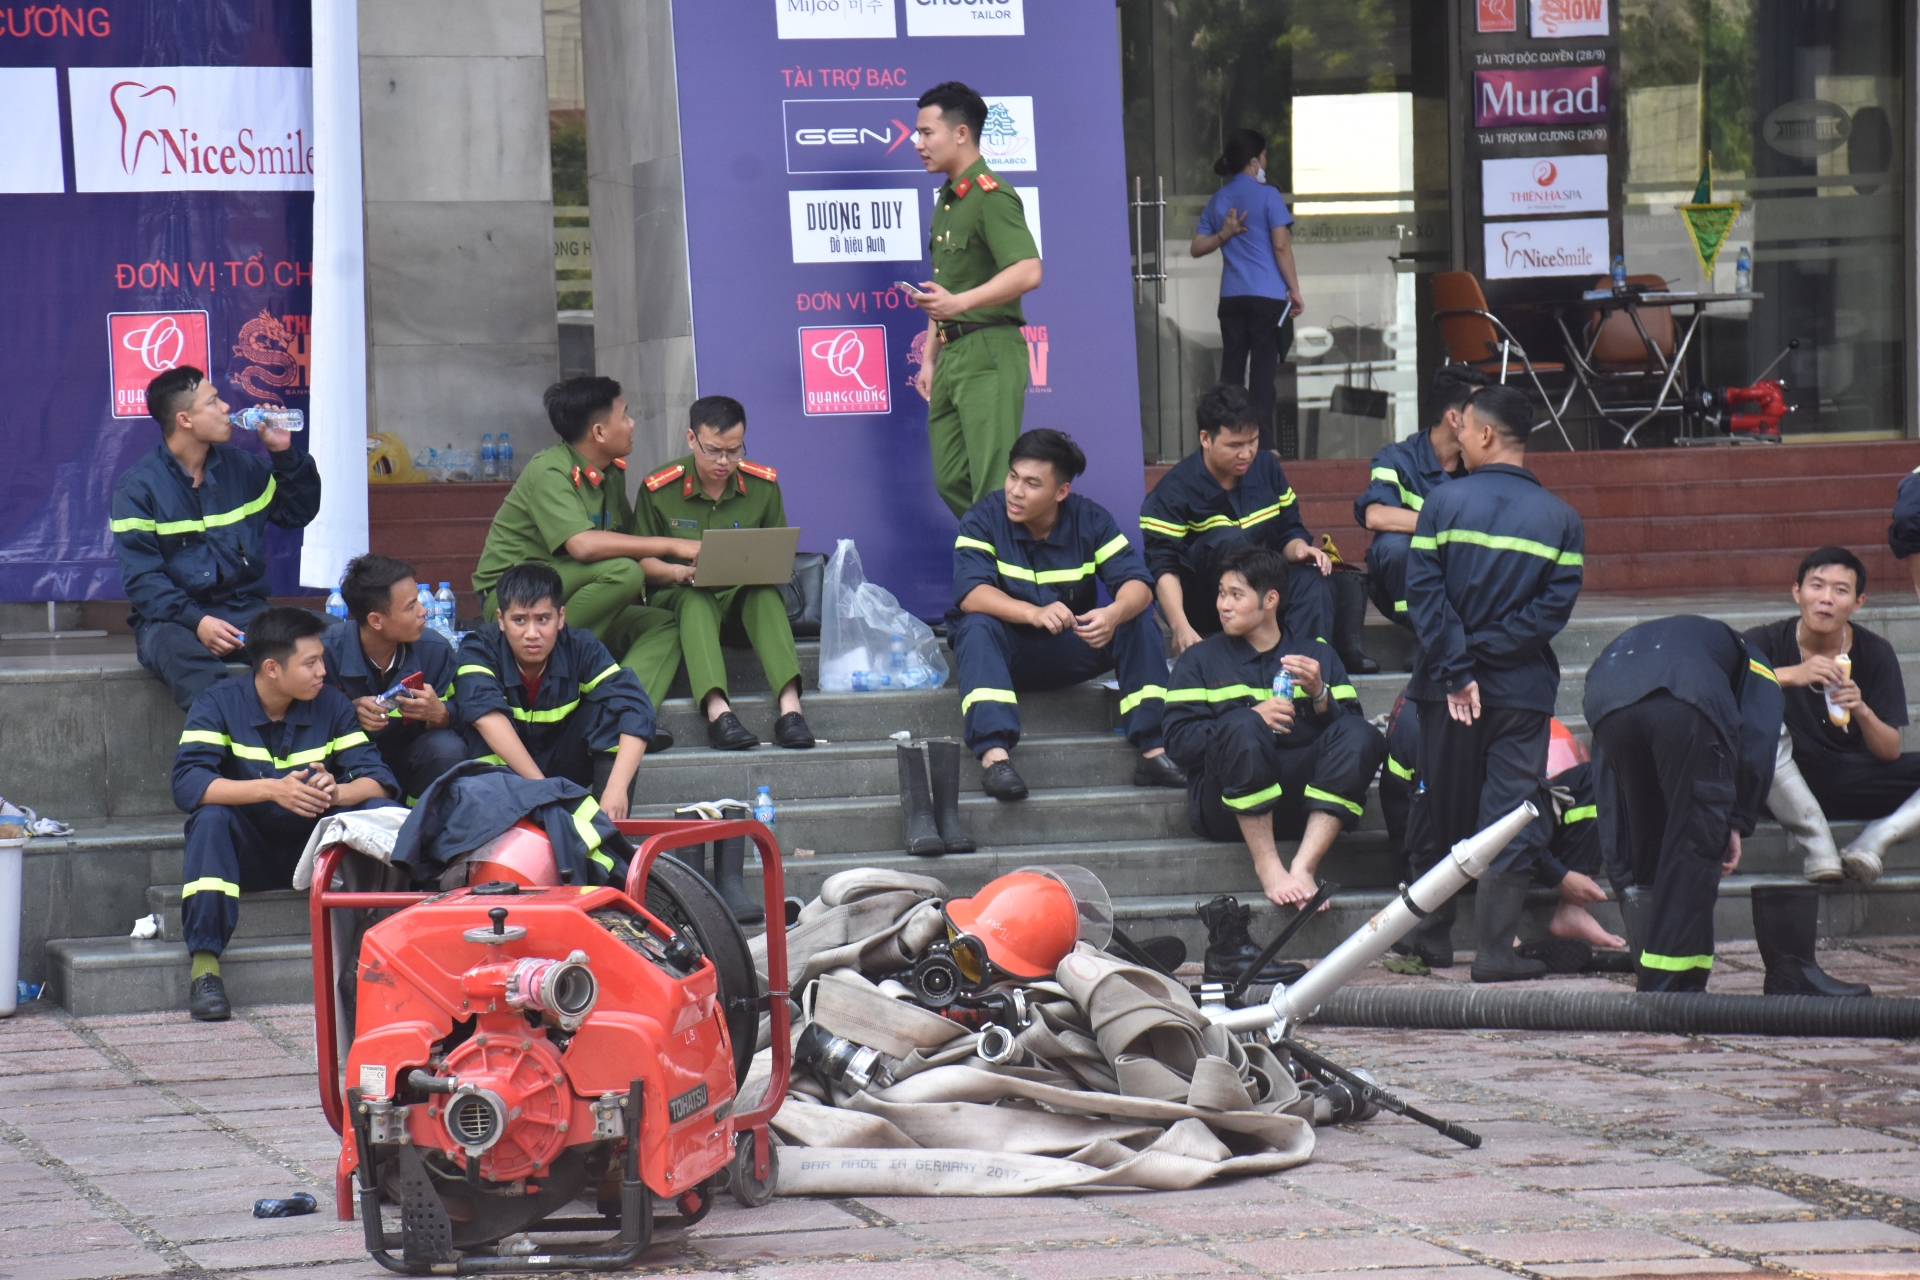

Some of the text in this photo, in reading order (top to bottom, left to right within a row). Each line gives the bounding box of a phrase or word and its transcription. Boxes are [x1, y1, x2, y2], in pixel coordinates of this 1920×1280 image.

[0, 4, 110, 37] ƯƠNG
[971, 10, 1011, 20] TAILOR
[1475, 48, 1606, 65] TÀI TRỢ ĐỘC QUYỀN (28/9)
[781, 65, 907, 90] TÀI TRỢ BẠC
[1478, 132, 1494, 144] TÀI
[1496, 132, 1517, 145] TRỢ
[1518, 132, 1537, 143] KIM
[1577, 128, 1607, 142] (29/9)
[806, 200, 902, 234] DƯƠNG DUY
[829, 234, 886, 255] Đồ hiệu Auth
[1522, 246, 1593, 269] NiceSmile
[115, 259, 180, 289] ĐƠN
[187, 261, 215, 292] VỊ
[223, 251, 265, 288] TỔ
[796, 290, 841, 312] ĐƠN
[847, 292, 867, 313] VỊ
[282, 315, 311, 334] TH
[1020, 325, 1048, 342] NG
[670, 1084, 708, 1120] TOHATSU
[801, 1160, 831, 1171] BAR
[841, 1158, 878, 1169] MADE
[889, 1158, 907, 1170] IN
[915, 1159, 978, 1174] GERMANY
